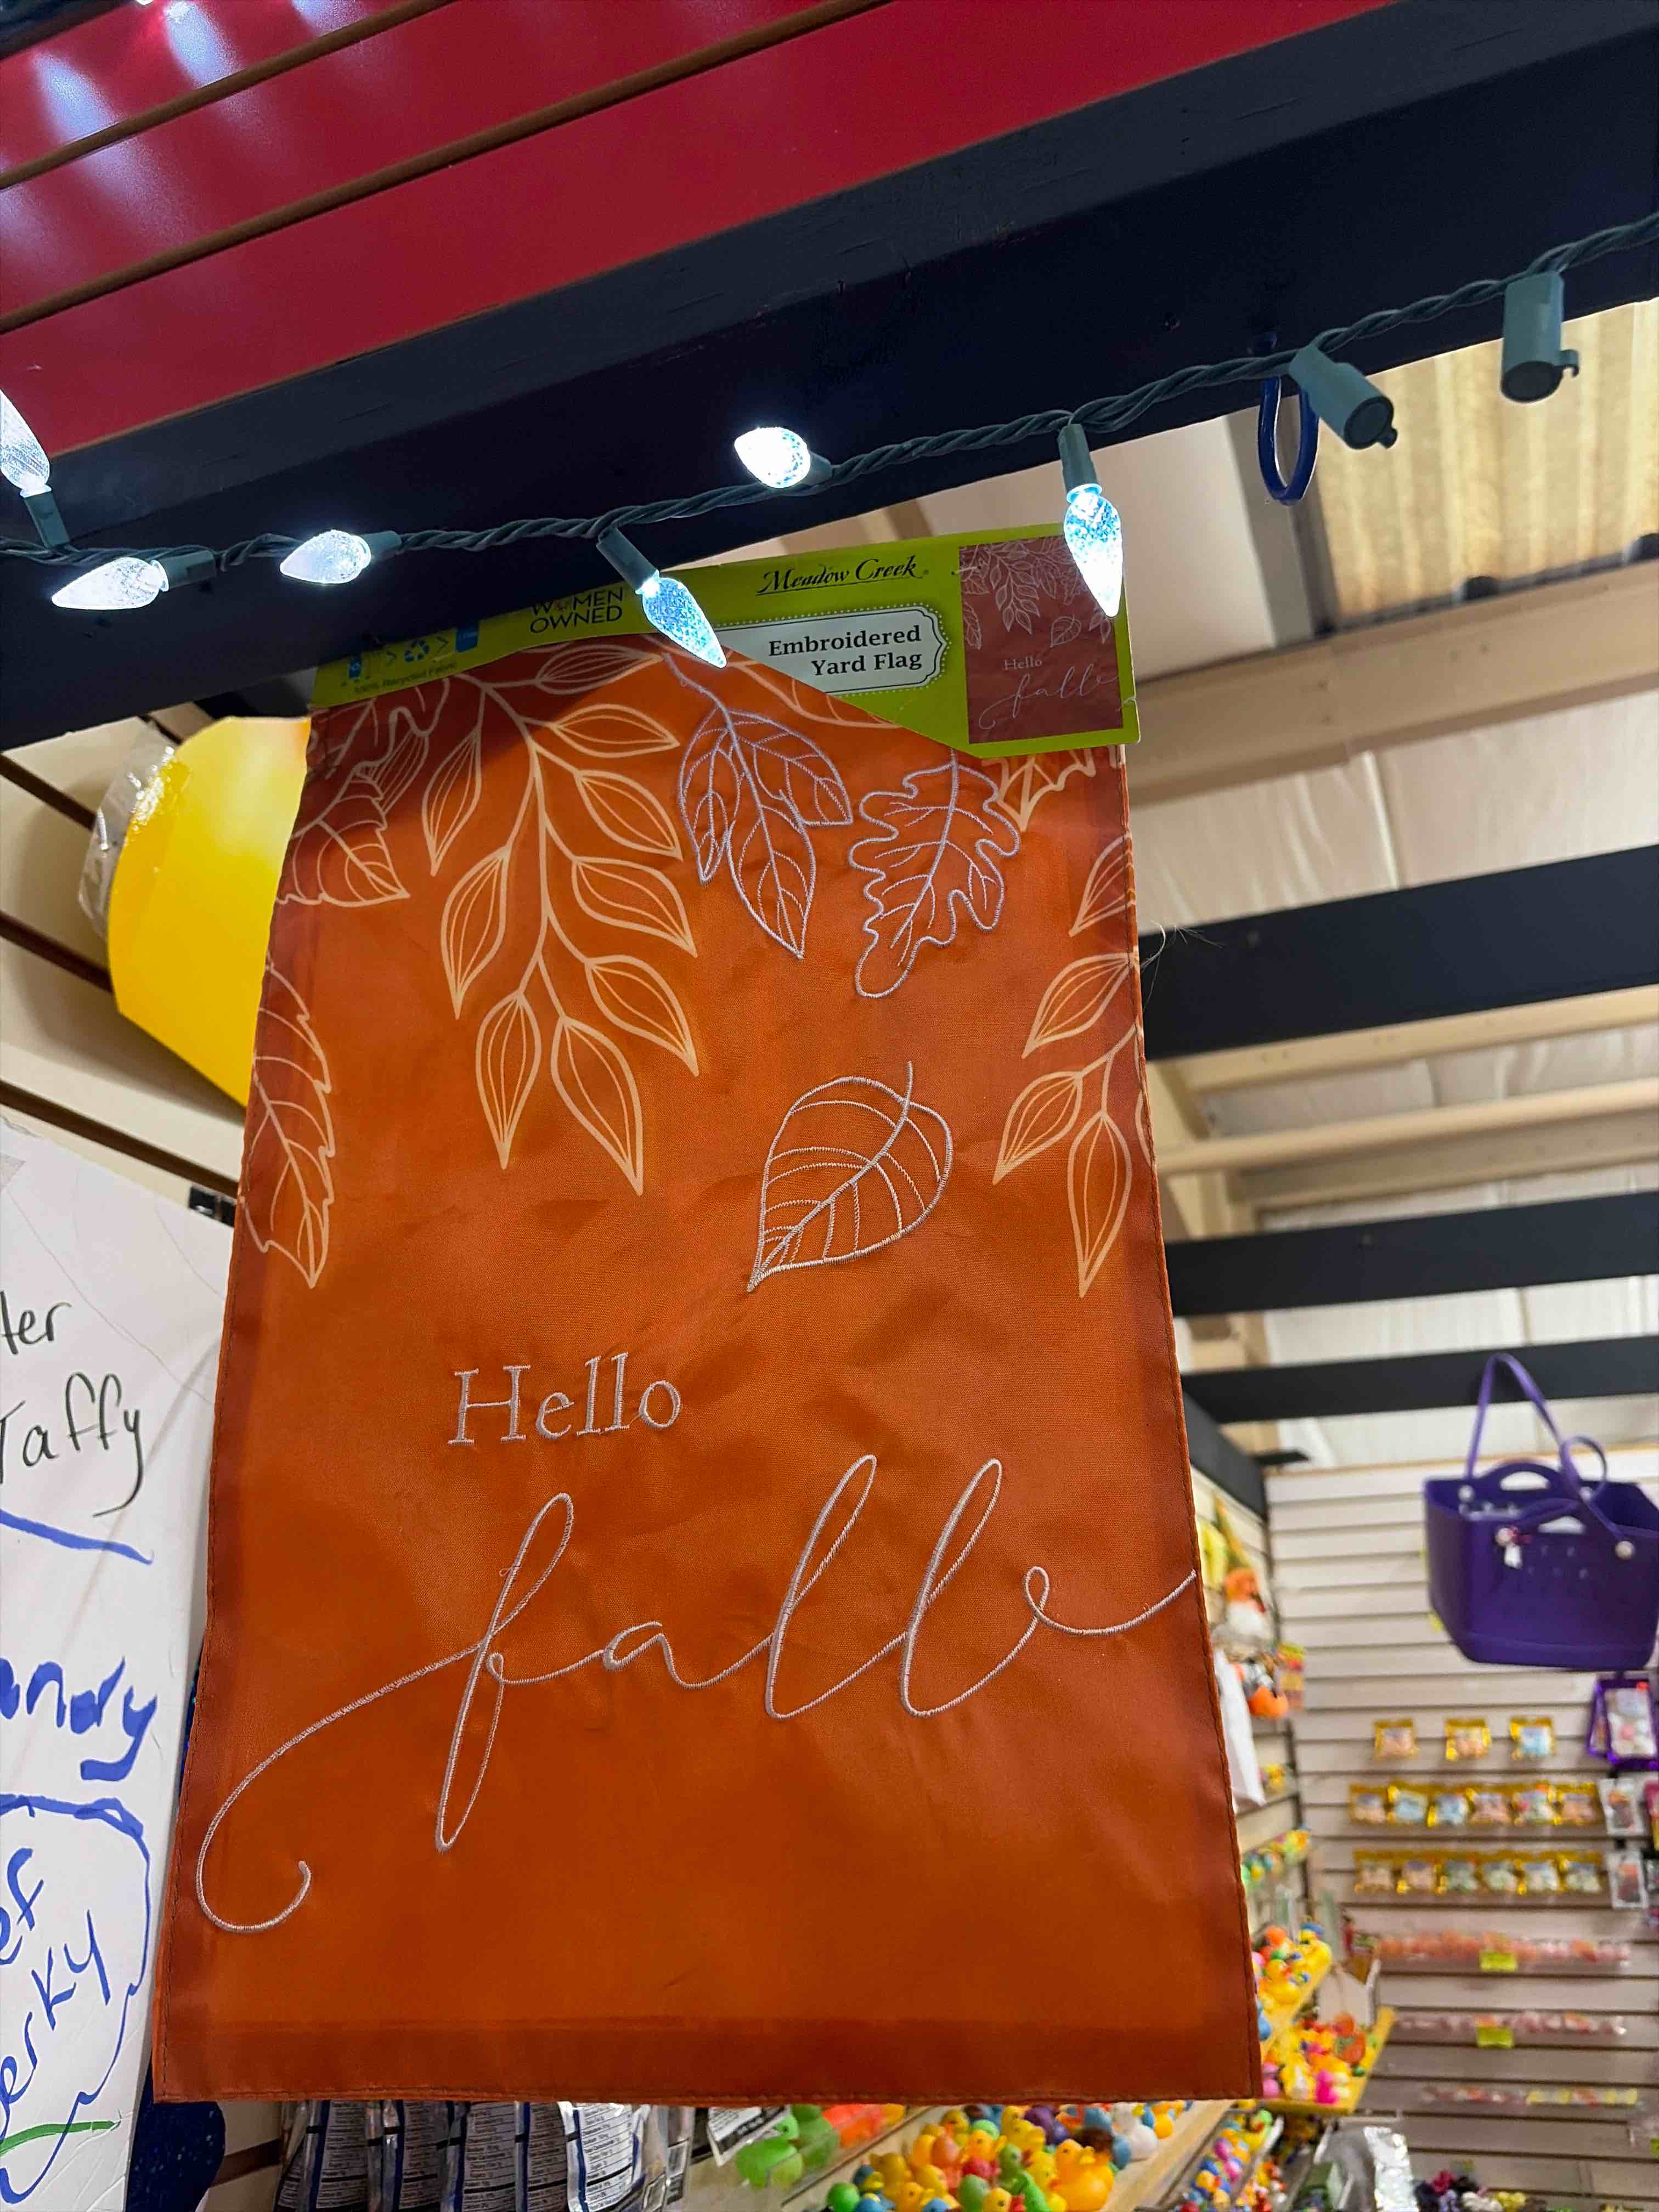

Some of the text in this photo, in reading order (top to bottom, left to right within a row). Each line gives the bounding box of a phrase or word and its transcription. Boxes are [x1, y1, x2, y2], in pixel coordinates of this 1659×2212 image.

[757, 555, 924, 595] Meadow Creek
[532, 586, 623, 615] WMEN
[530, 605, 623, 633] OWNED
[769, 625, 922, 656] Embroidered
[811, 652, 922, 676] Yard Flag
[1004, 656, 1042, 670] Hello
[978, 663, 1120, 730] fall
[447, 1351, 683, 1447] Hello
[0, 1372, 144, 1518] Taffy
[195, 1453, 1199, 1933] fall
